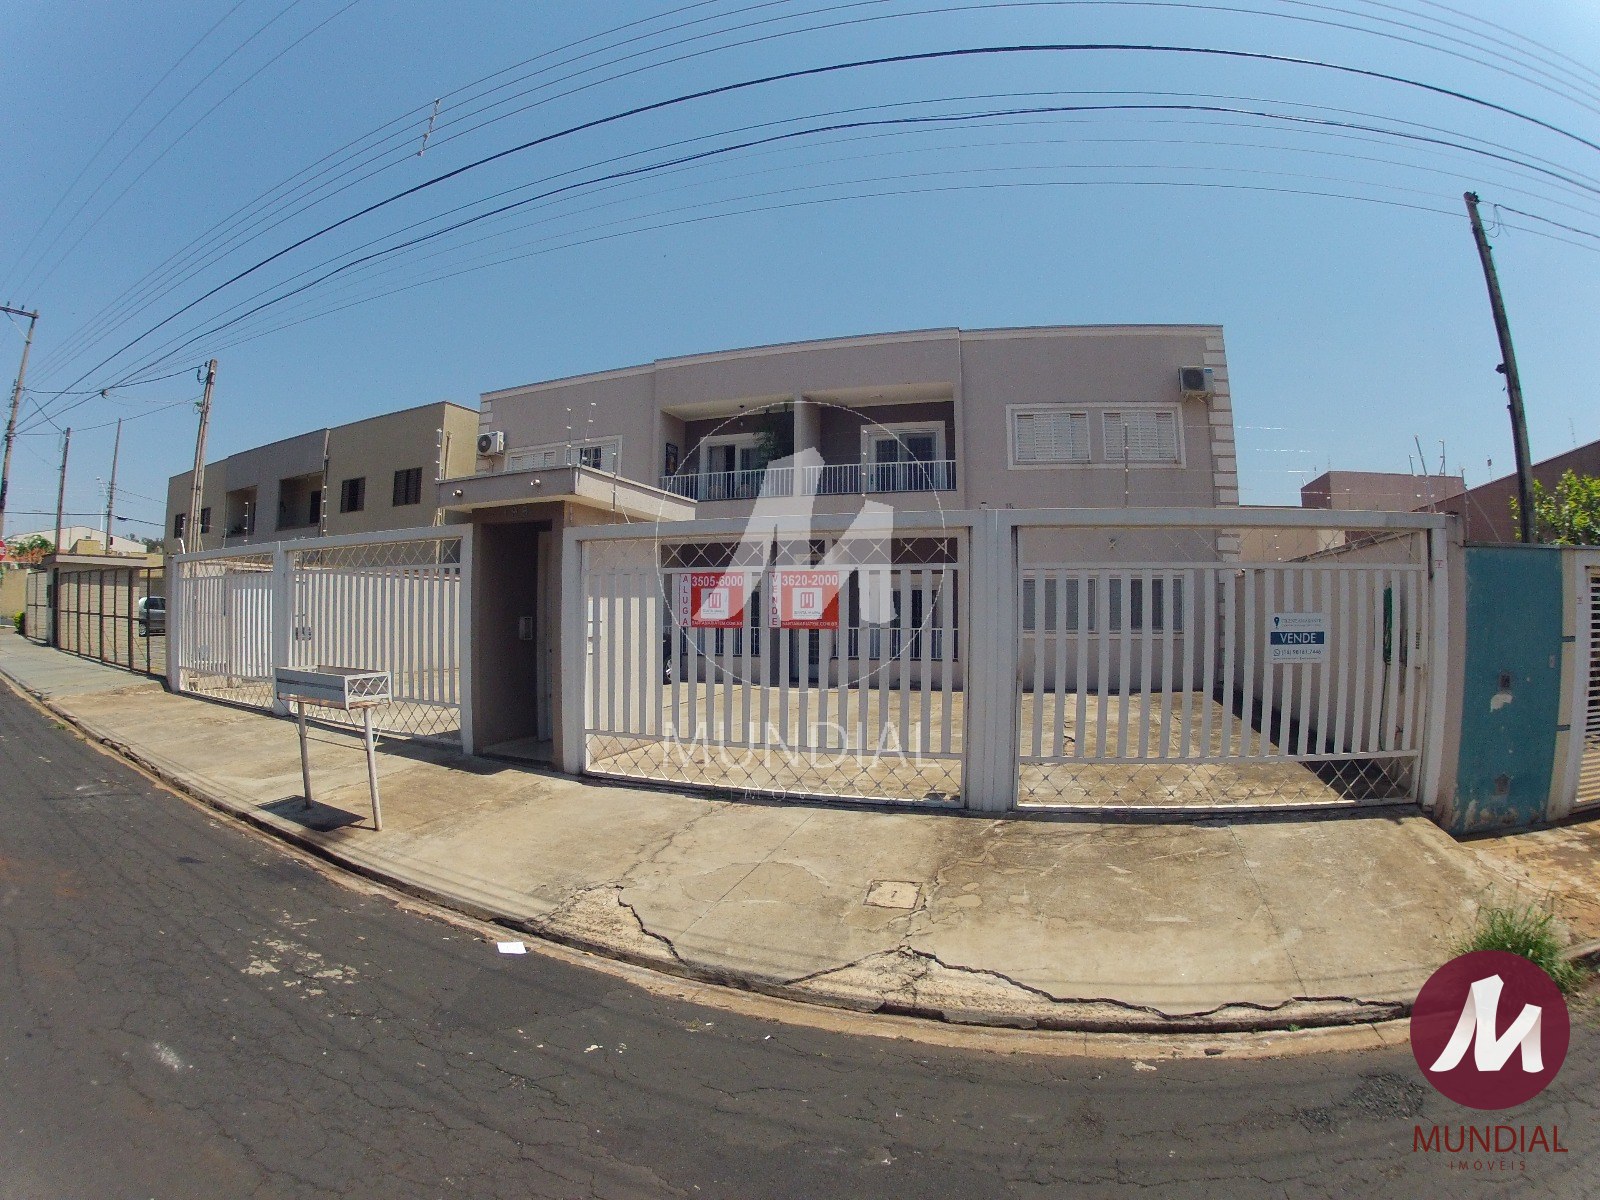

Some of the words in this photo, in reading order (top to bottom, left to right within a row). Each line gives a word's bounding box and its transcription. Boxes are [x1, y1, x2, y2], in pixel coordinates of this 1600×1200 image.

[692, 575, 743, 587] 3505-6000
[782, 574, 838, 586] 3620-2000
[1280, 632, 1317, 644] VENDE
